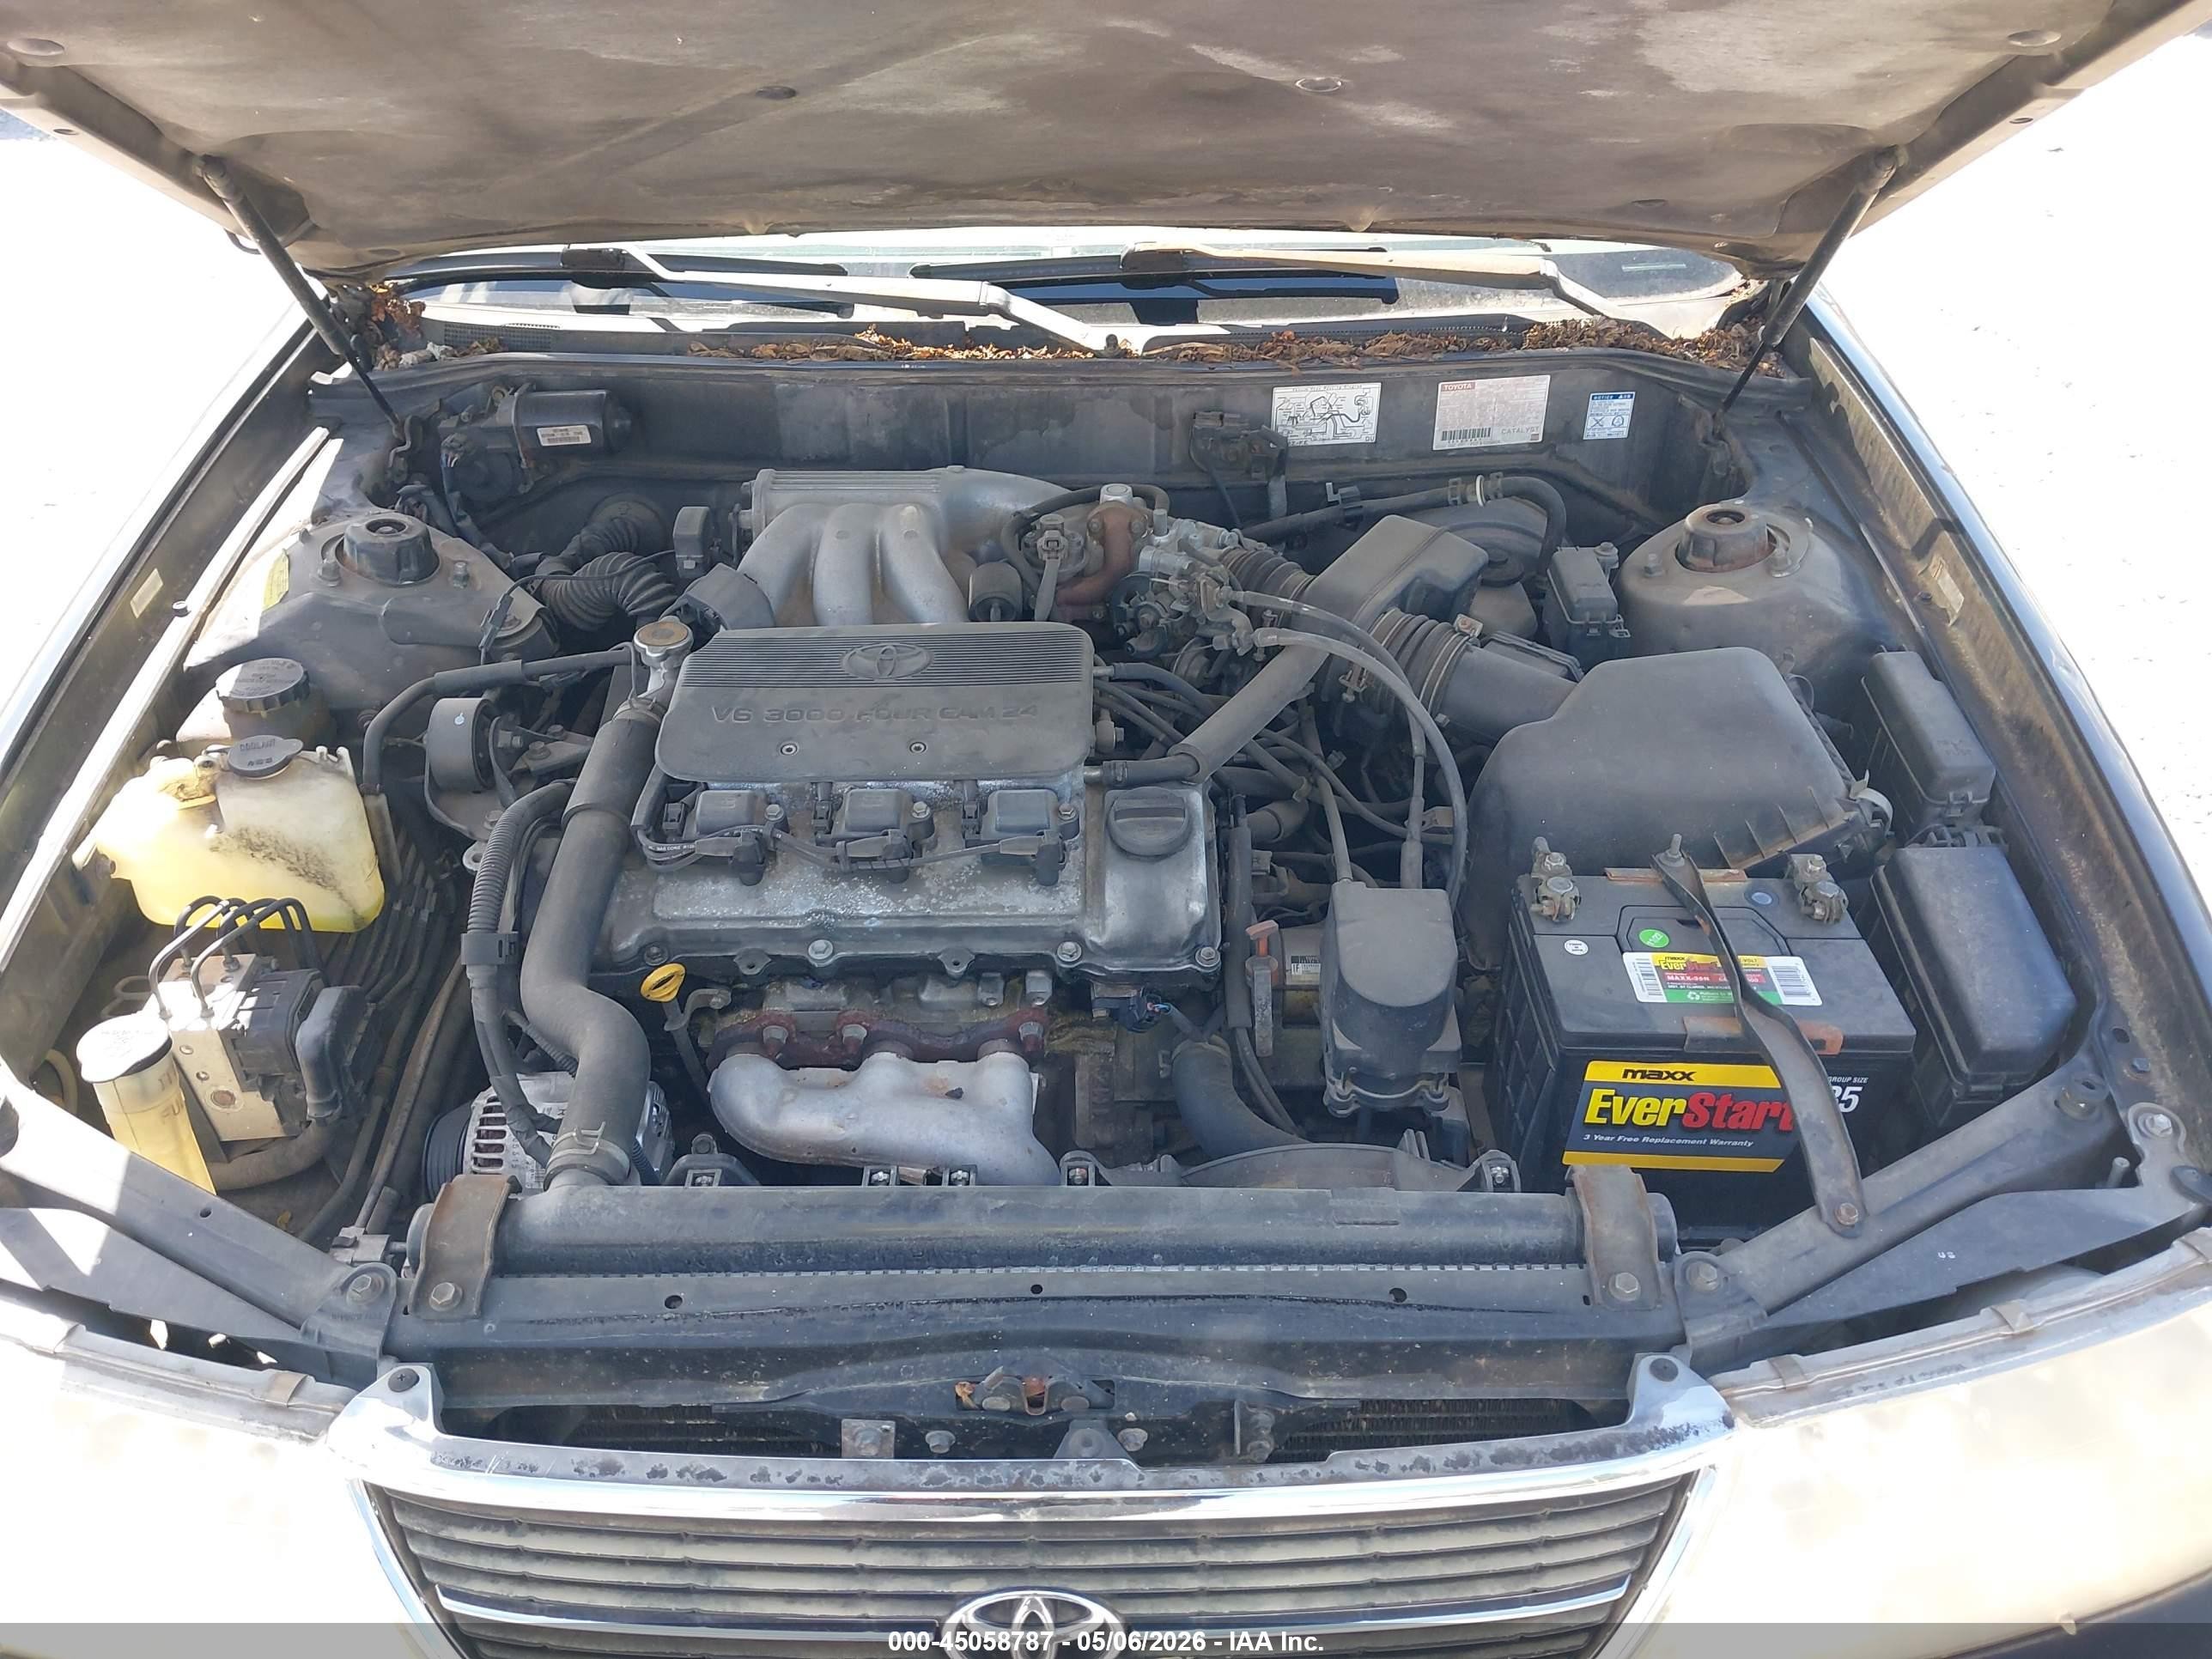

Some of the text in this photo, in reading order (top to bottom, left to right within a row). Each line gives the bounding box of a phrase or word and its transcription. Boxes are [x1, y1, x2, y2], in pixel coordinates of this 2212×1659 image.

[1501, 426, 1540, 434] CATALYST
[710, 707, 752, 723] V6
[763, 706, 847, 723] 3000
[856, 707, 932, 722] FOUR
[1002, 704, 1039, 720] 24
[1622, 1069, 1697, 1081] maxx
[1584, 1088, 1793, 1131] EverStart
[1642, 1136, 1707, 1146] Replacement
[1709, 1139, 1753, 1147] Warranty
